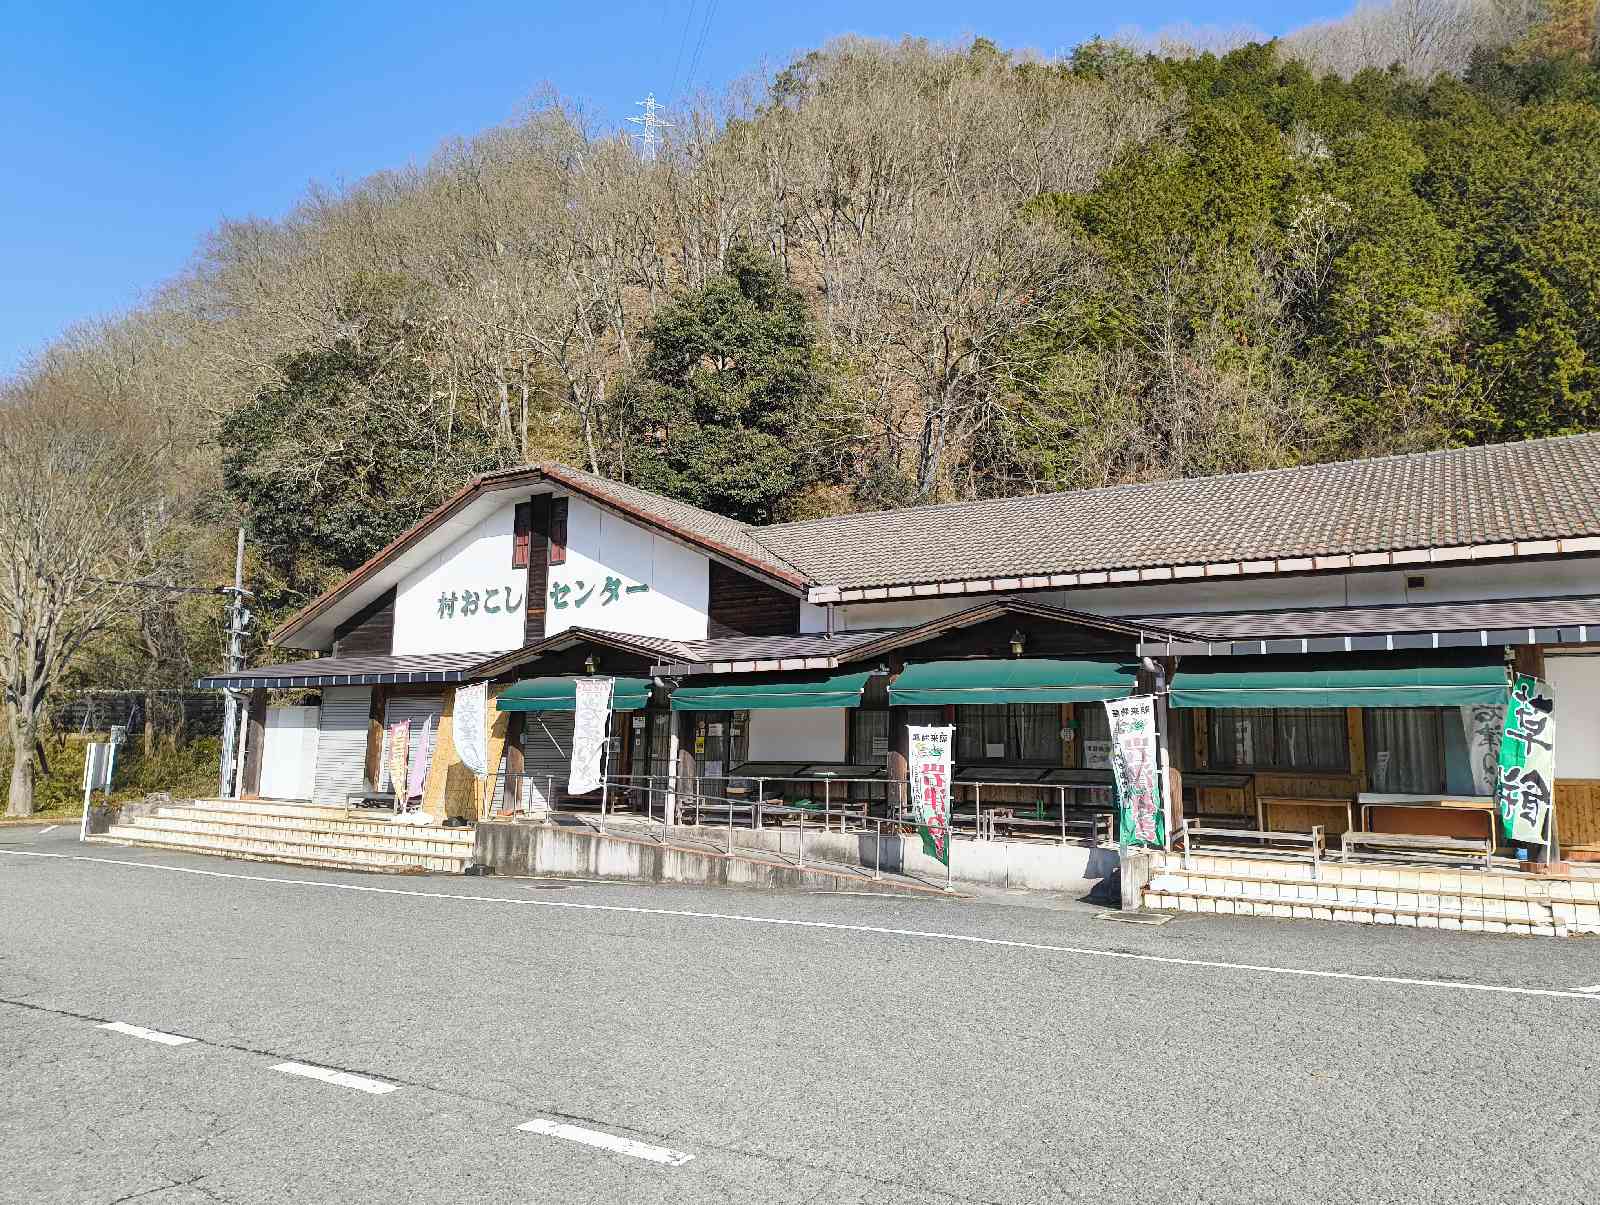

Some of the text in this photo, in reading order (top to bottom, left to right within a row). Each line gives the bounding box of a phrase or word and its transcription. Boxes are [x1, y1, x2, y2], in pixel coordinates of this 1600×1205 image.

[437, 576, 650, 620] 村おこしセンター
